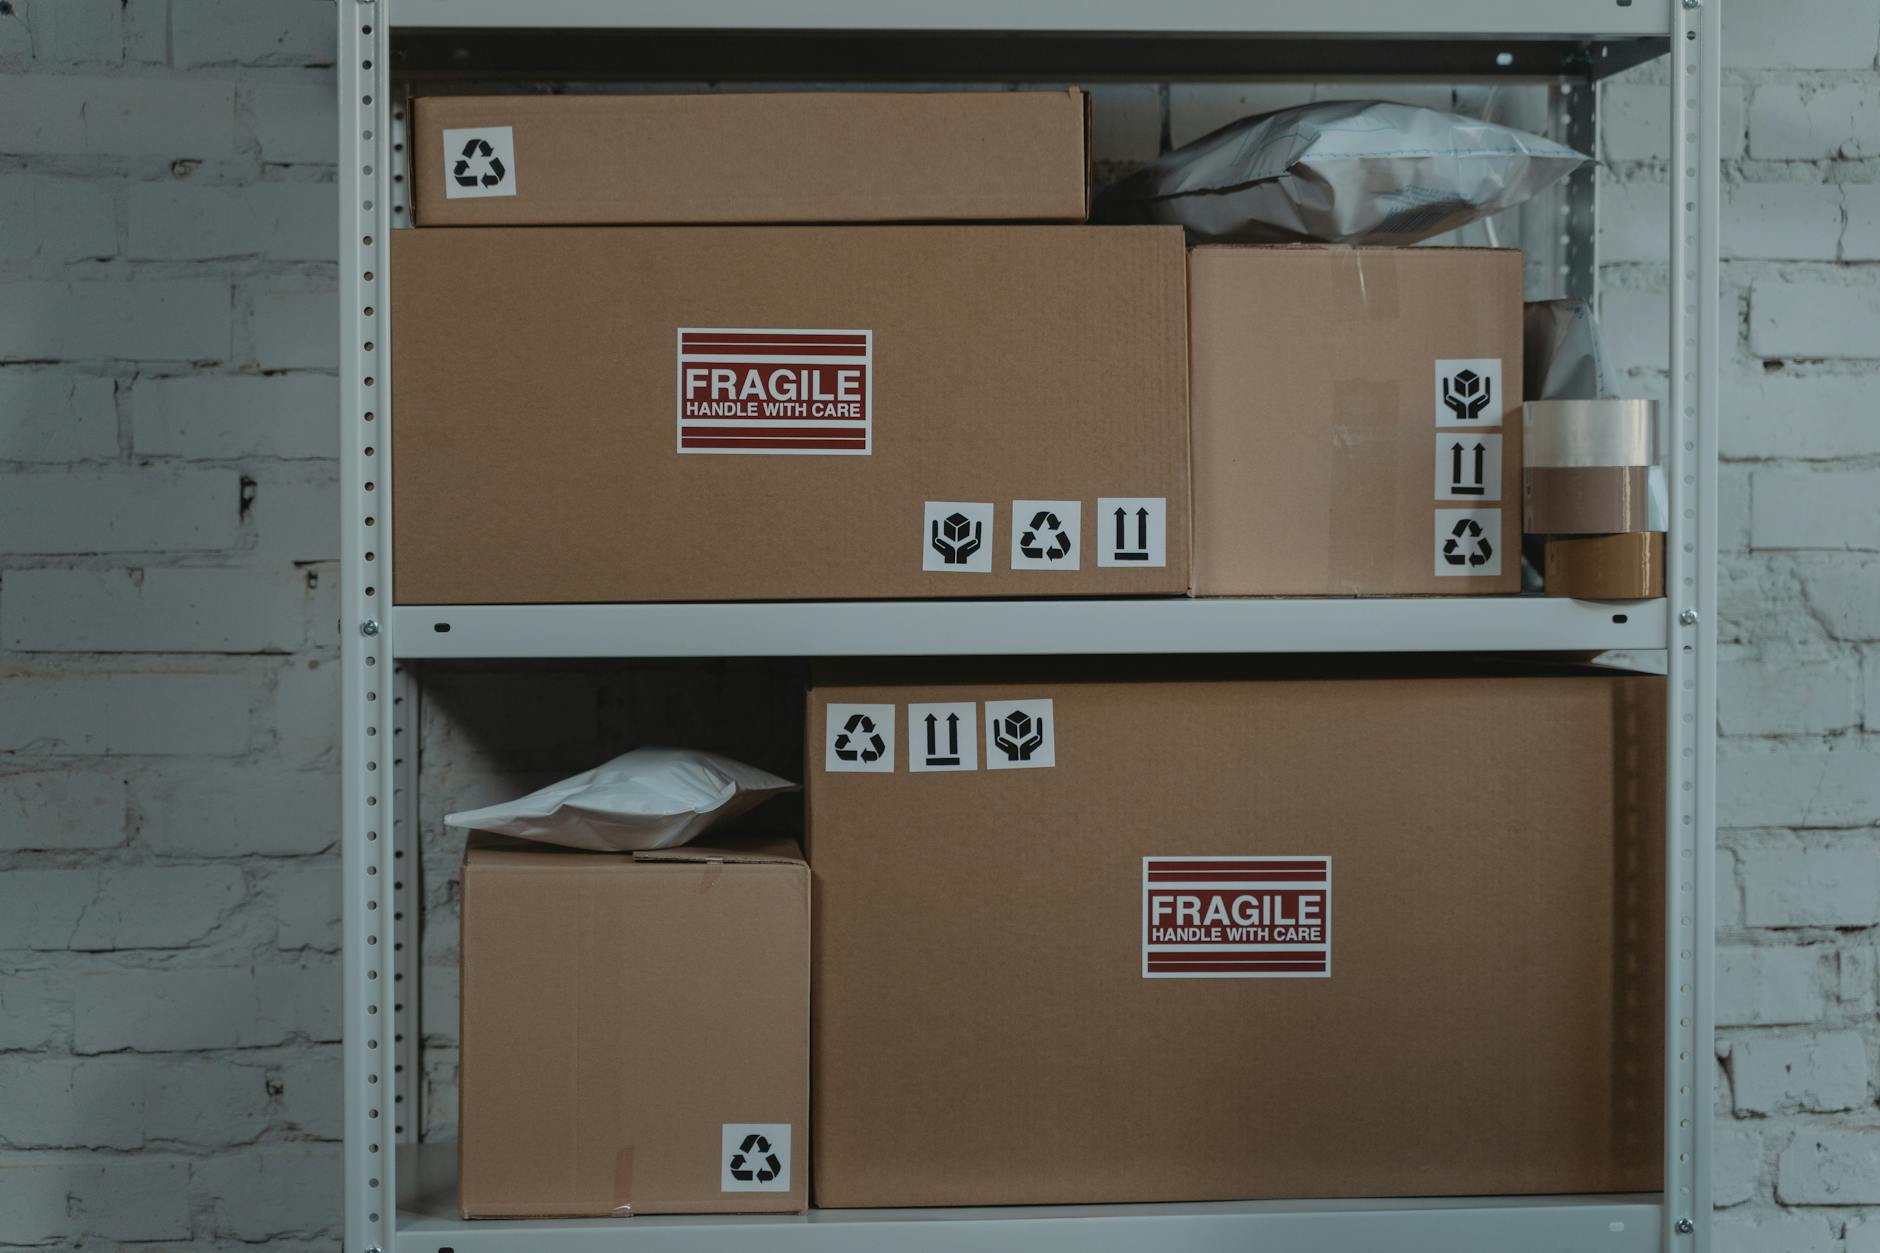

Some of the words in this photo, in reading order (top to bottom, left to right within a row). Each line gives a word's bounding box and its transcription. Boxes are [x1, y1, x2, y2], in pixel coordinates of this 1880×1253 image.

[686, 368, 861, 402] FRAGILE
[686, 402, 758, 416] HANDLE
[763, 402, 807, 417] WITH
[812, 403, 861, 417] CARE
[1152, 894, 1321, 926] FRAGILE
[1152, 927, 1222, 942] HANDLE
[1226, 927, 1269, 941] WITH
[1273, 927, 1321, 941] CARE
